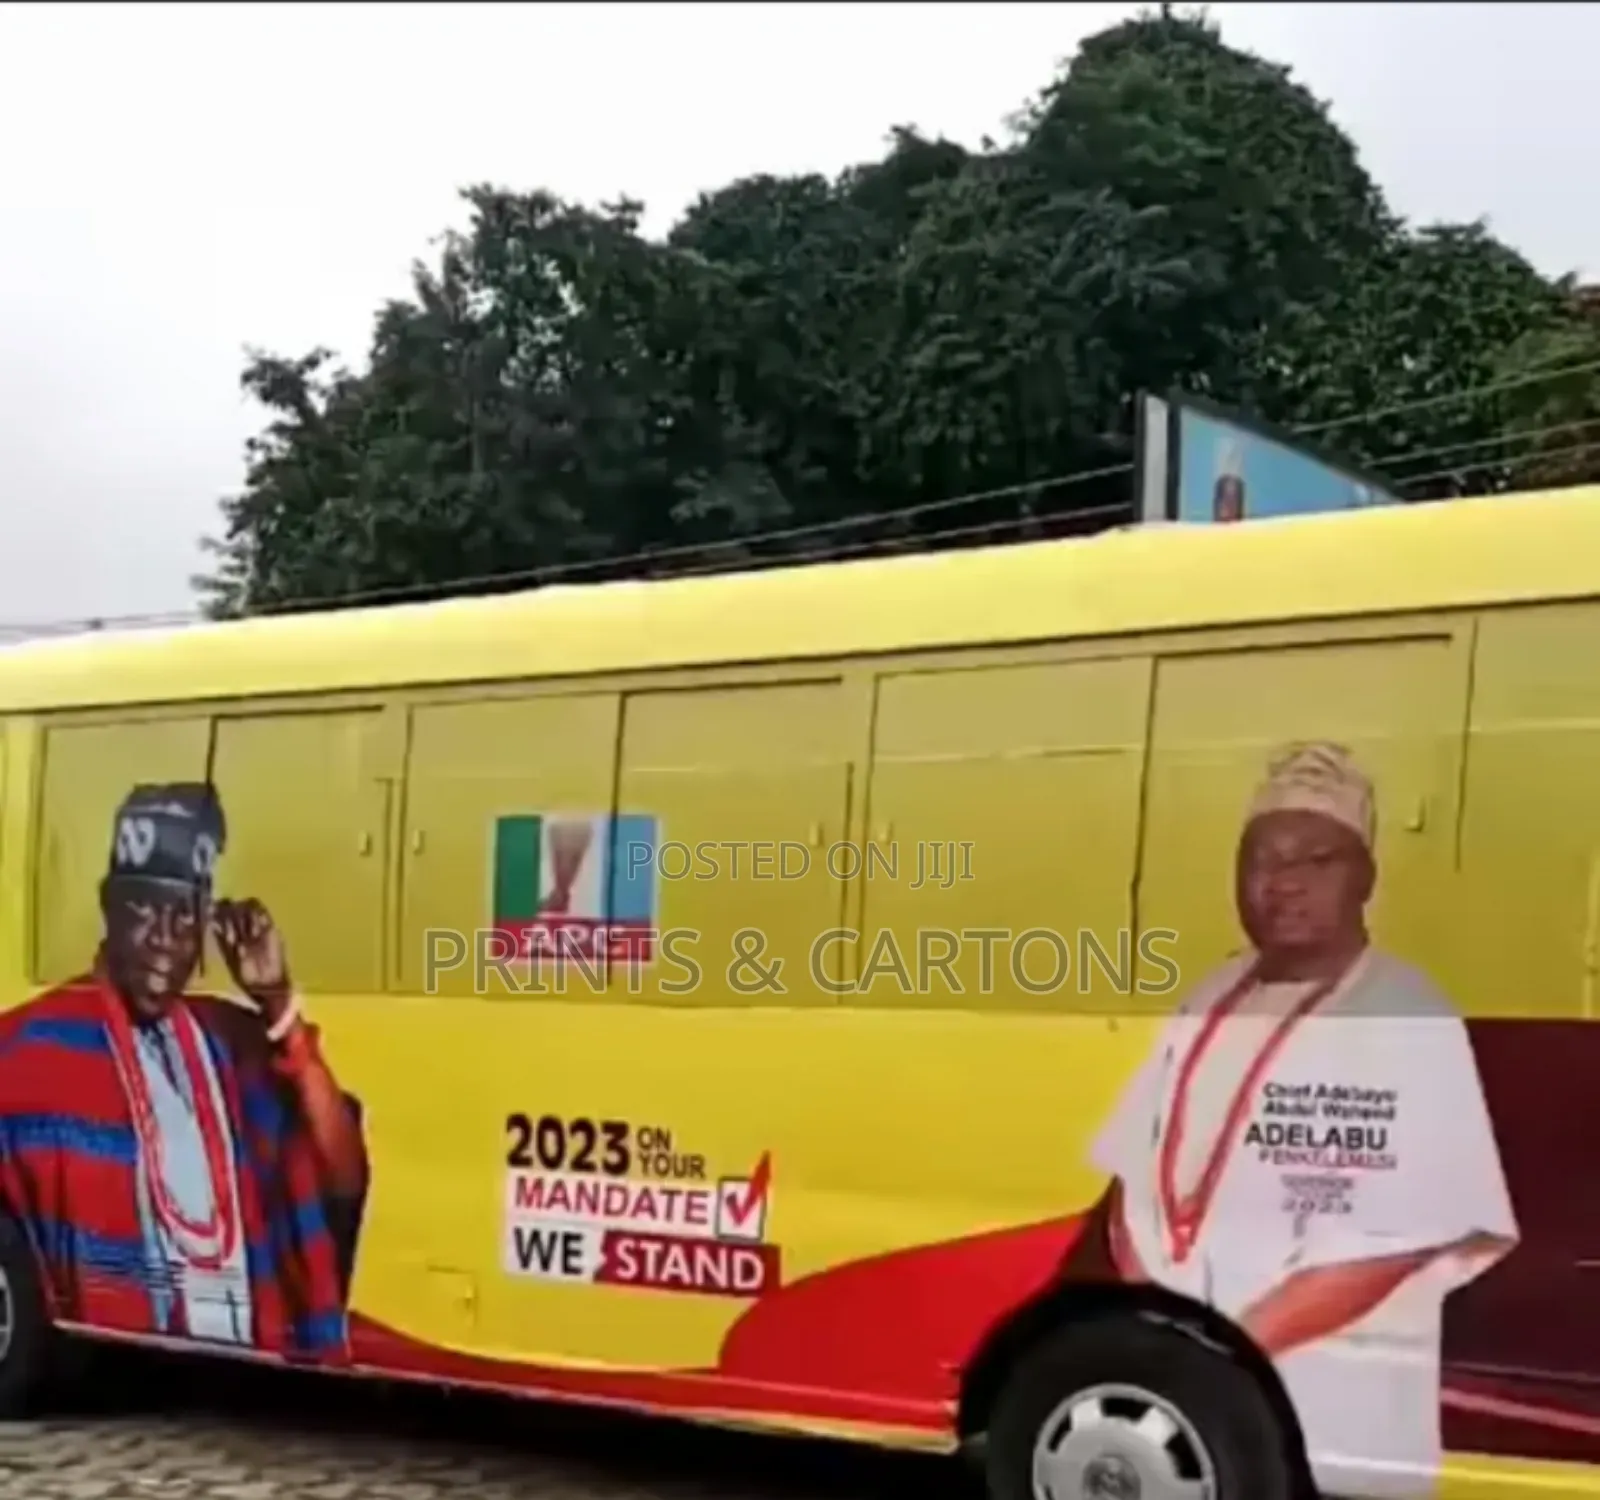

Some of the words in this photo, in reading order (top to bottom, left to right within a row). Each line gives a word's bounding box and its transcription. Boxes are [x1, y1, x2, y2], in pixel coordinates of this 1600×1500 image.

[1264, 1082, 1311, 1099] Chief
[506, 1113, 631, 1177] 2023
[636, 1126, 672, 1152] ON
[1244, 1122, 1388, 1152] ADELABU
[638, 1152, 707, 1179] YOUR
[514, 1175, 710, 1225] MANDATE
[513, 1226, 584, 1276] WE
[615, 1237, 766, 1289] STAND
